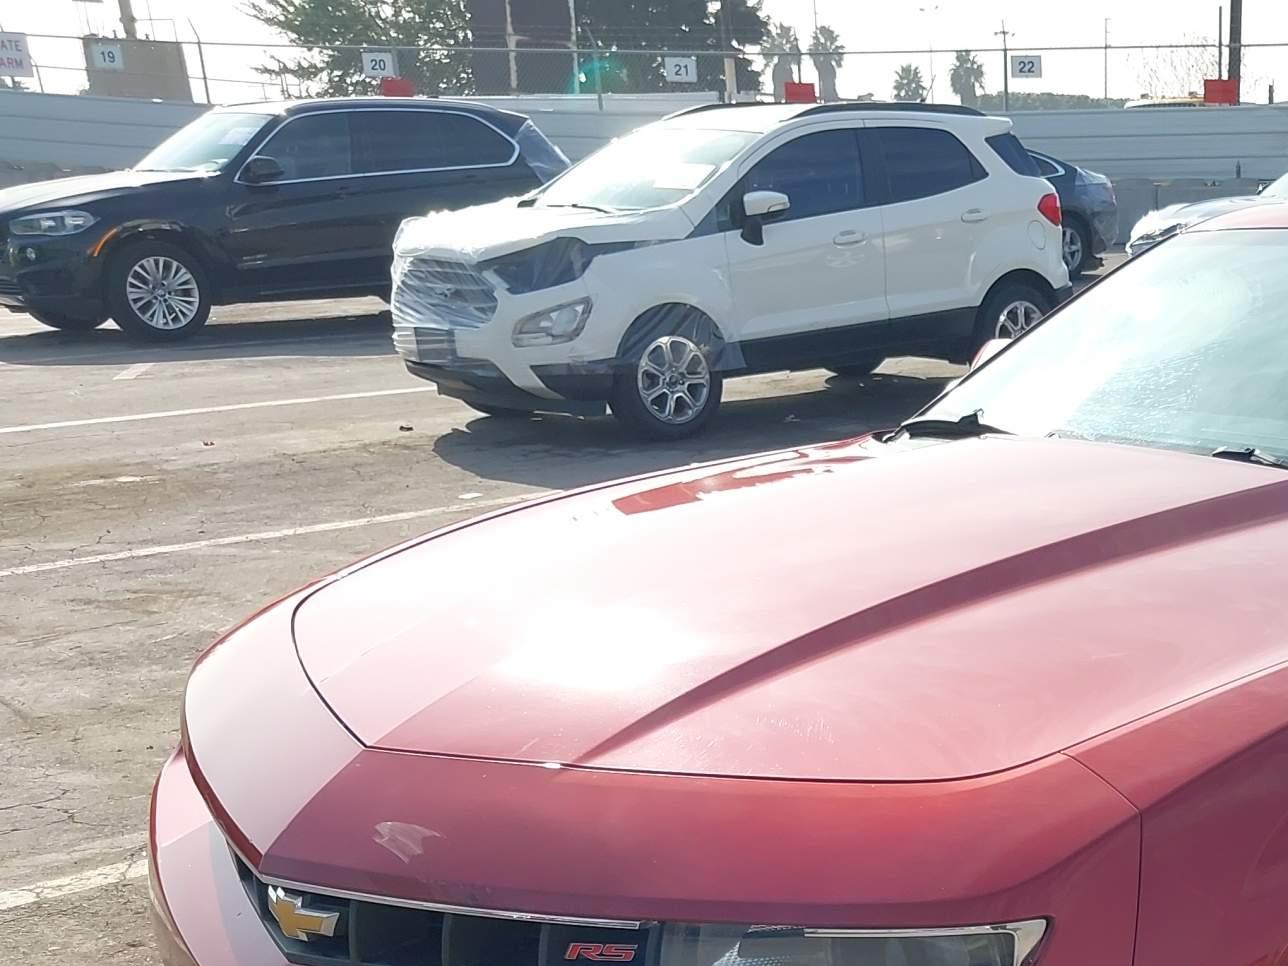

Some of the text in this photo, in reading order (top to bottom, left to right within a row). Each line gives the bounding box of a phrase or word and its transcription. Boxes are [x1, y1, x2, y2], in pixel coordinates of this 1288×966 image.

[101, 50, 116, 63] 19
[370, 58, 386, 71] 20
[673, 63, 689, 77] 21
[1018, 60, 1035, 73] 22
[564, 942, 639, 962] RS
